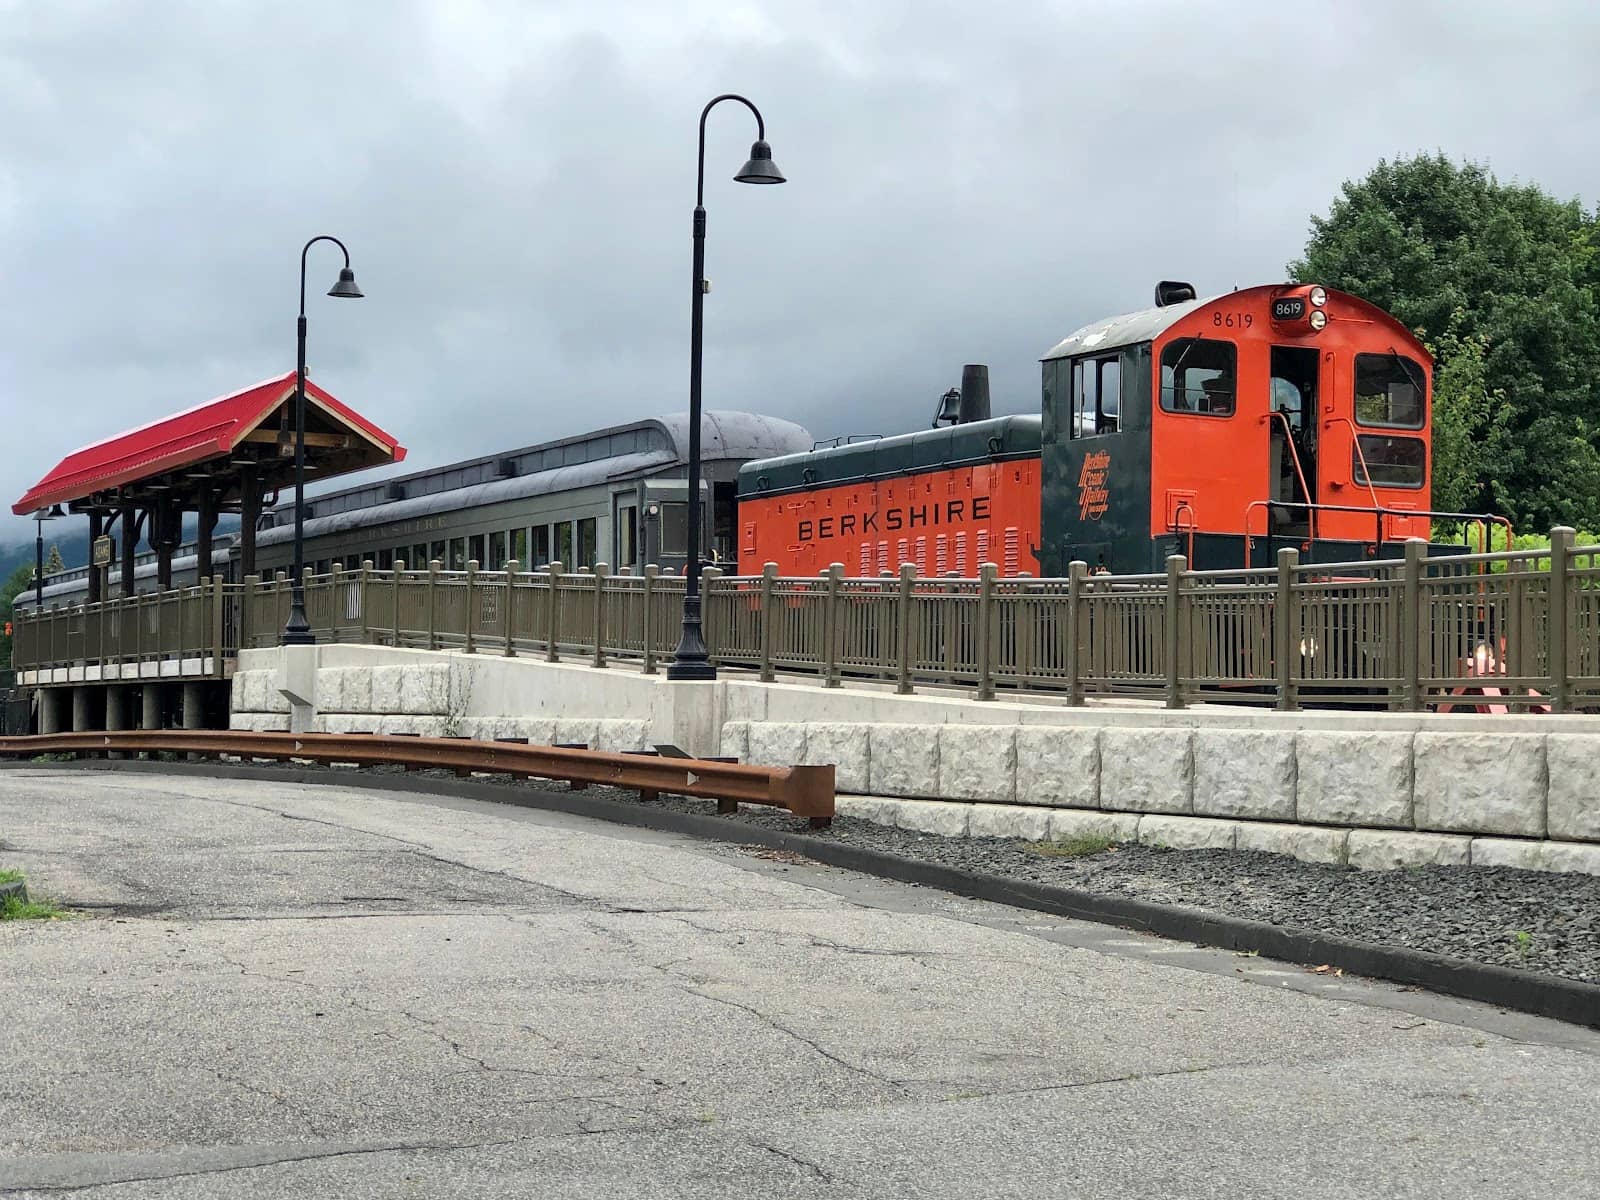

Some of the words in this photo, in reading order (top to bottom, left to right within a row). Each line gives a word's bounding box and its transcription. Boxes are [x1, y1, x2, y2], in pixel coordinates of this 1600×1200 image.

[1276, 302, 1301, 315] 8619
[1213, 311, 1253, 329] 8619
[799, 496, 991, 542] BERKSHIRE
